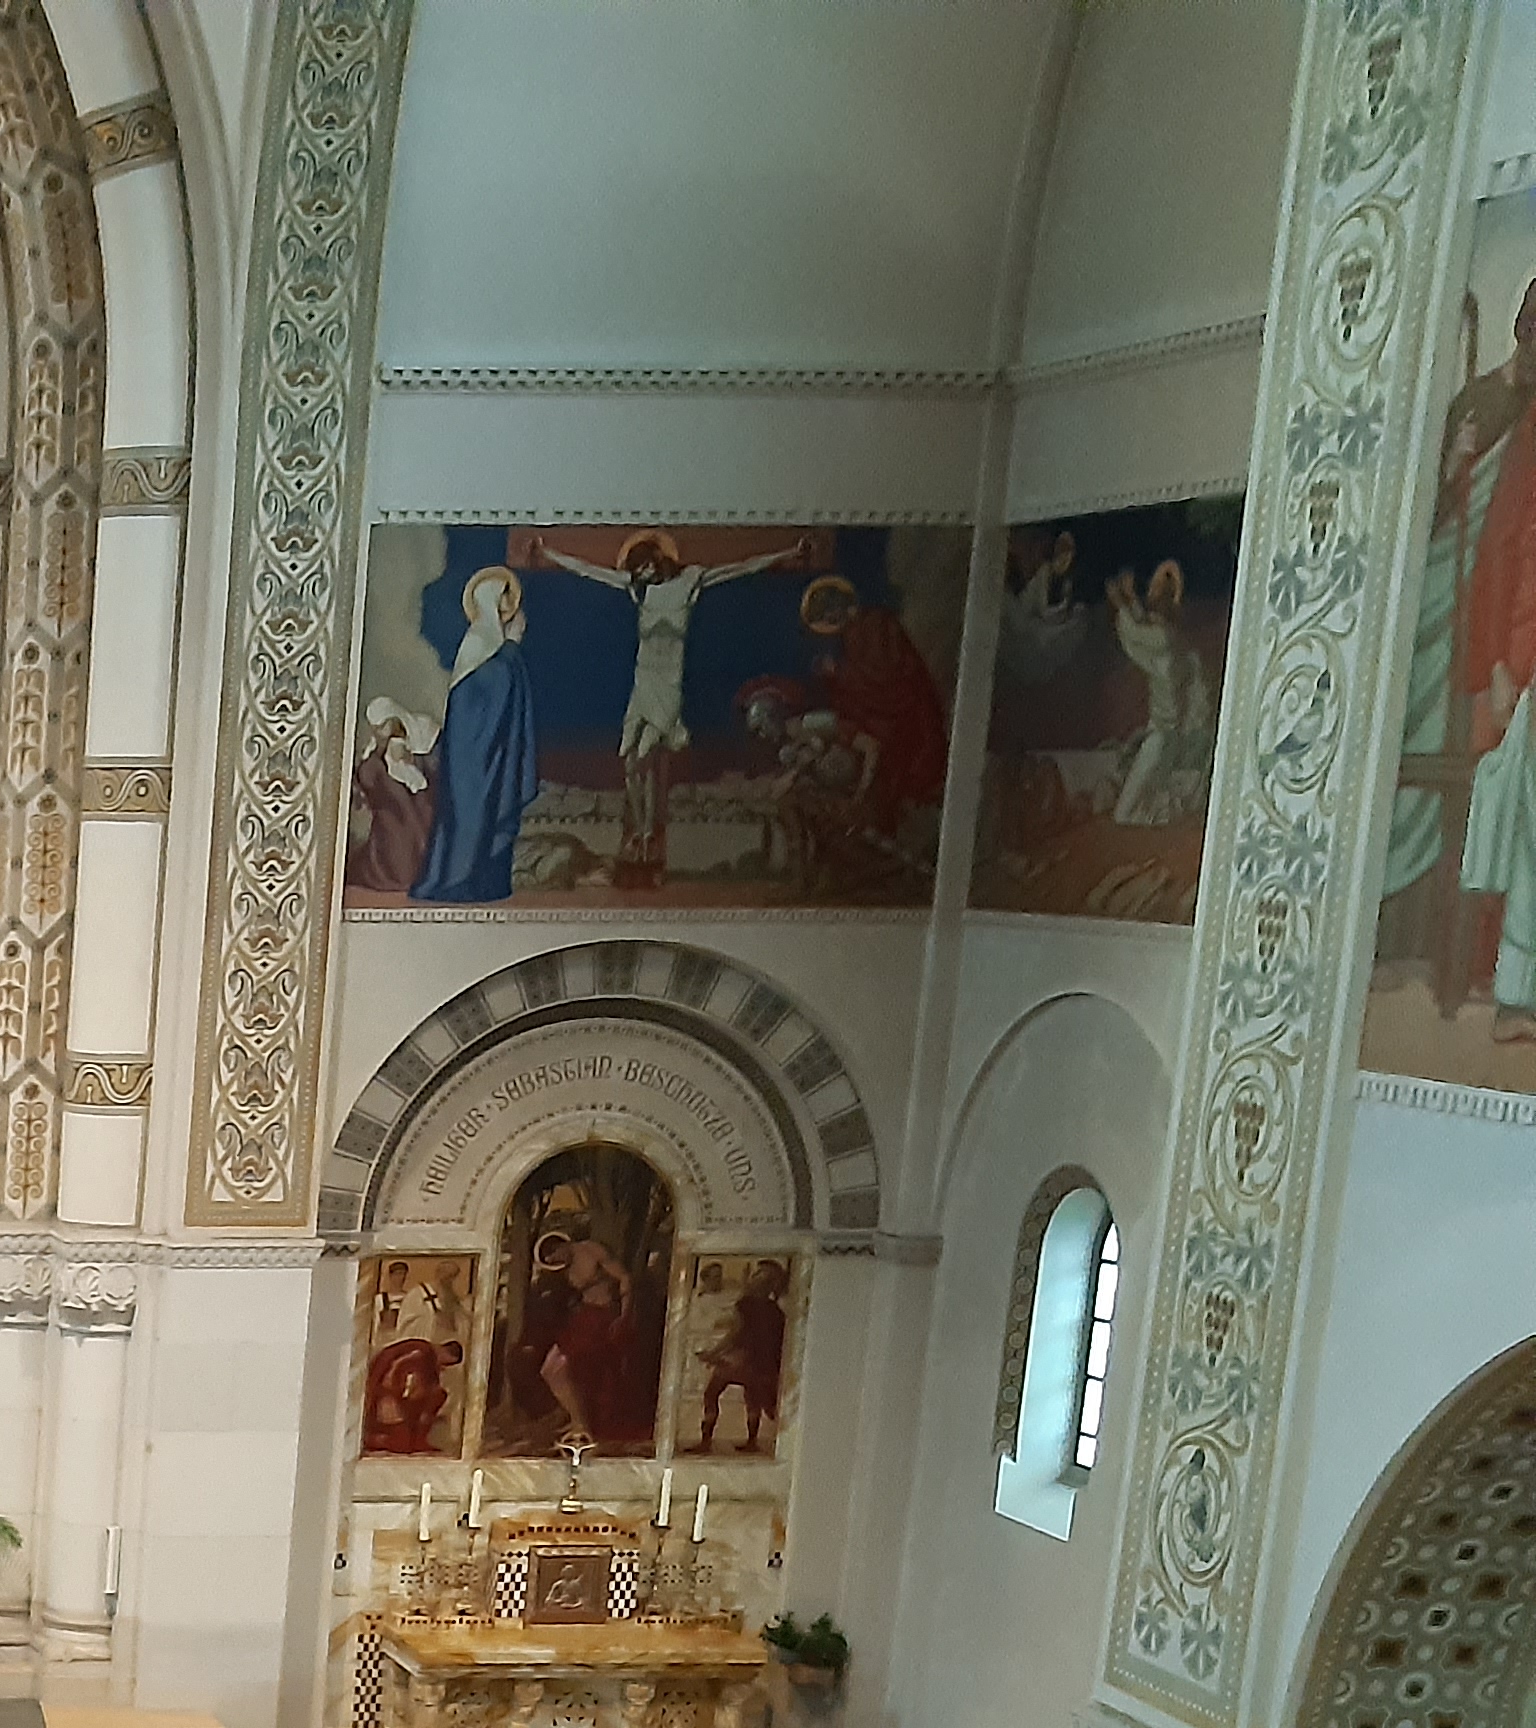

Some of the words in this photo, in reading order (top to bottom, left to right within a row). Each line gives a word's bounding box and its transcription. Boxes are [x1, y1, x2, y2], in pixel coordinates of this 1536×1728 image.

[419, 1107, 490, 1195] HEILIGER
[491, 1055, 612, 1111] SEBASTIAN
[723, 1147, 756, 1193] UNS
